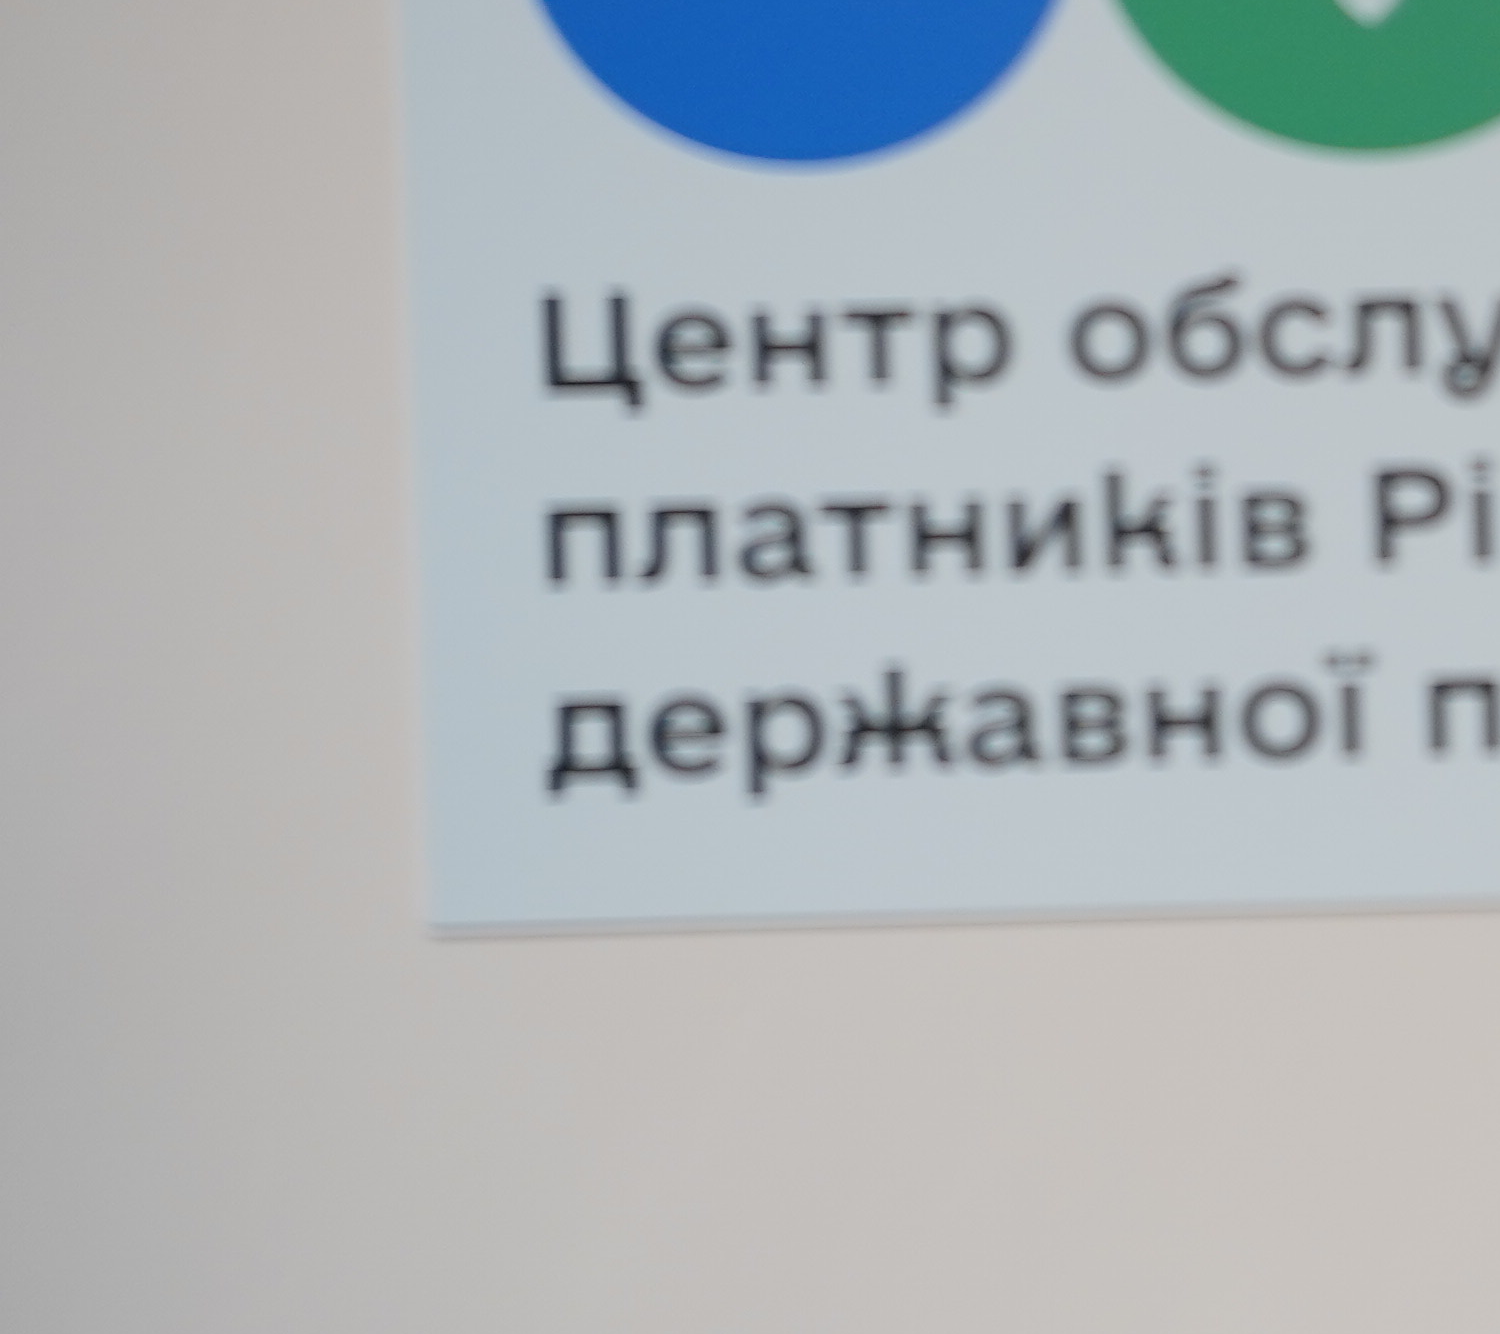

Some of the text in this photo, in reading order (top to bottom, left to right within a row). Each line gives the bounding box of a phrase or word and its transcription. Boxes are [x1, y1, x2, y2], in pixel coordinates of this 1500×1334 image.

[537, 287, 1016, 417] Центр
[542, 464, 1313, 591] платників
[542, 652, 1374, 803] державної
